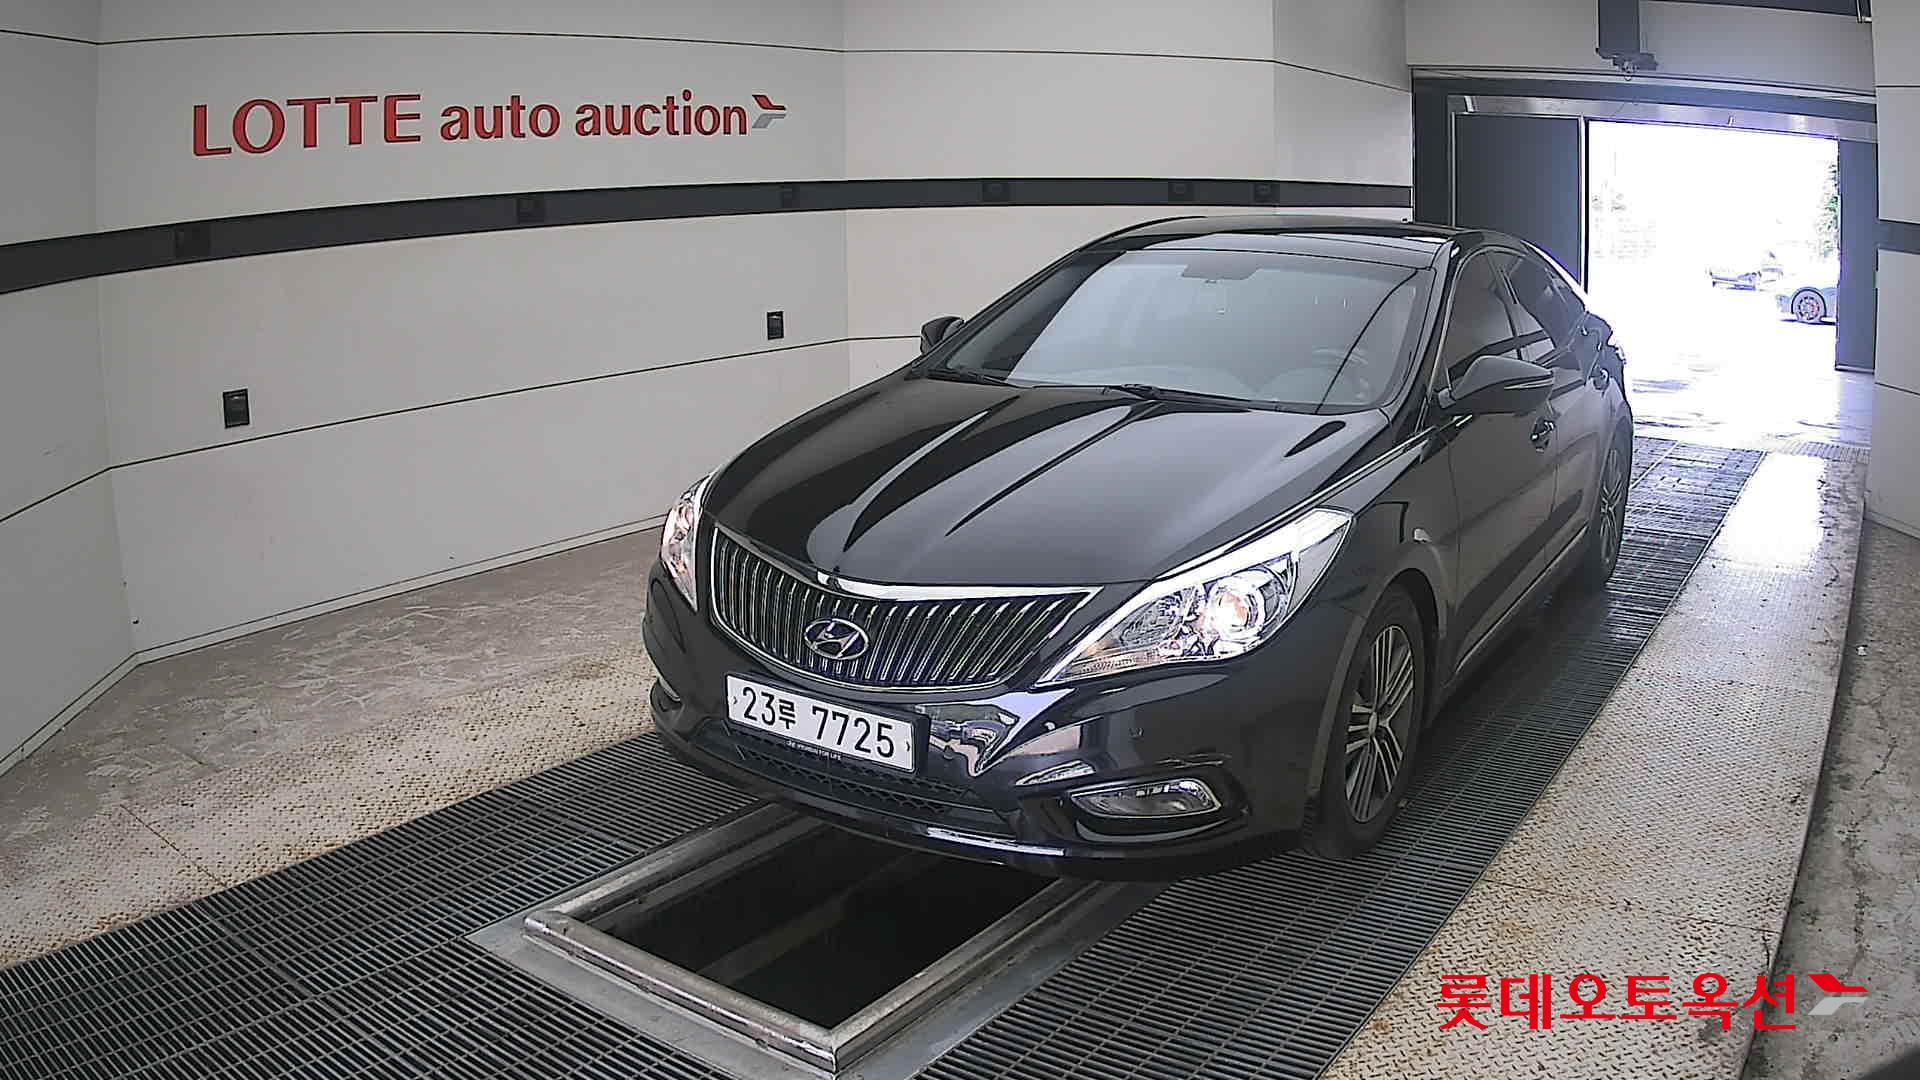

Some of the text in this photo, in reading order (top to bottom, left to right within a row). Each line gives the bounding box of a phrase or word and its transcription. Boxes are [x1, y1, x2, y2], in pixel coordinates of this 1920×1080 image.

[192, 89, 748, 156] LOTTE auto auction
[742, 686, 796, 729] 23루
[812, 705, 895, 758] 7725
